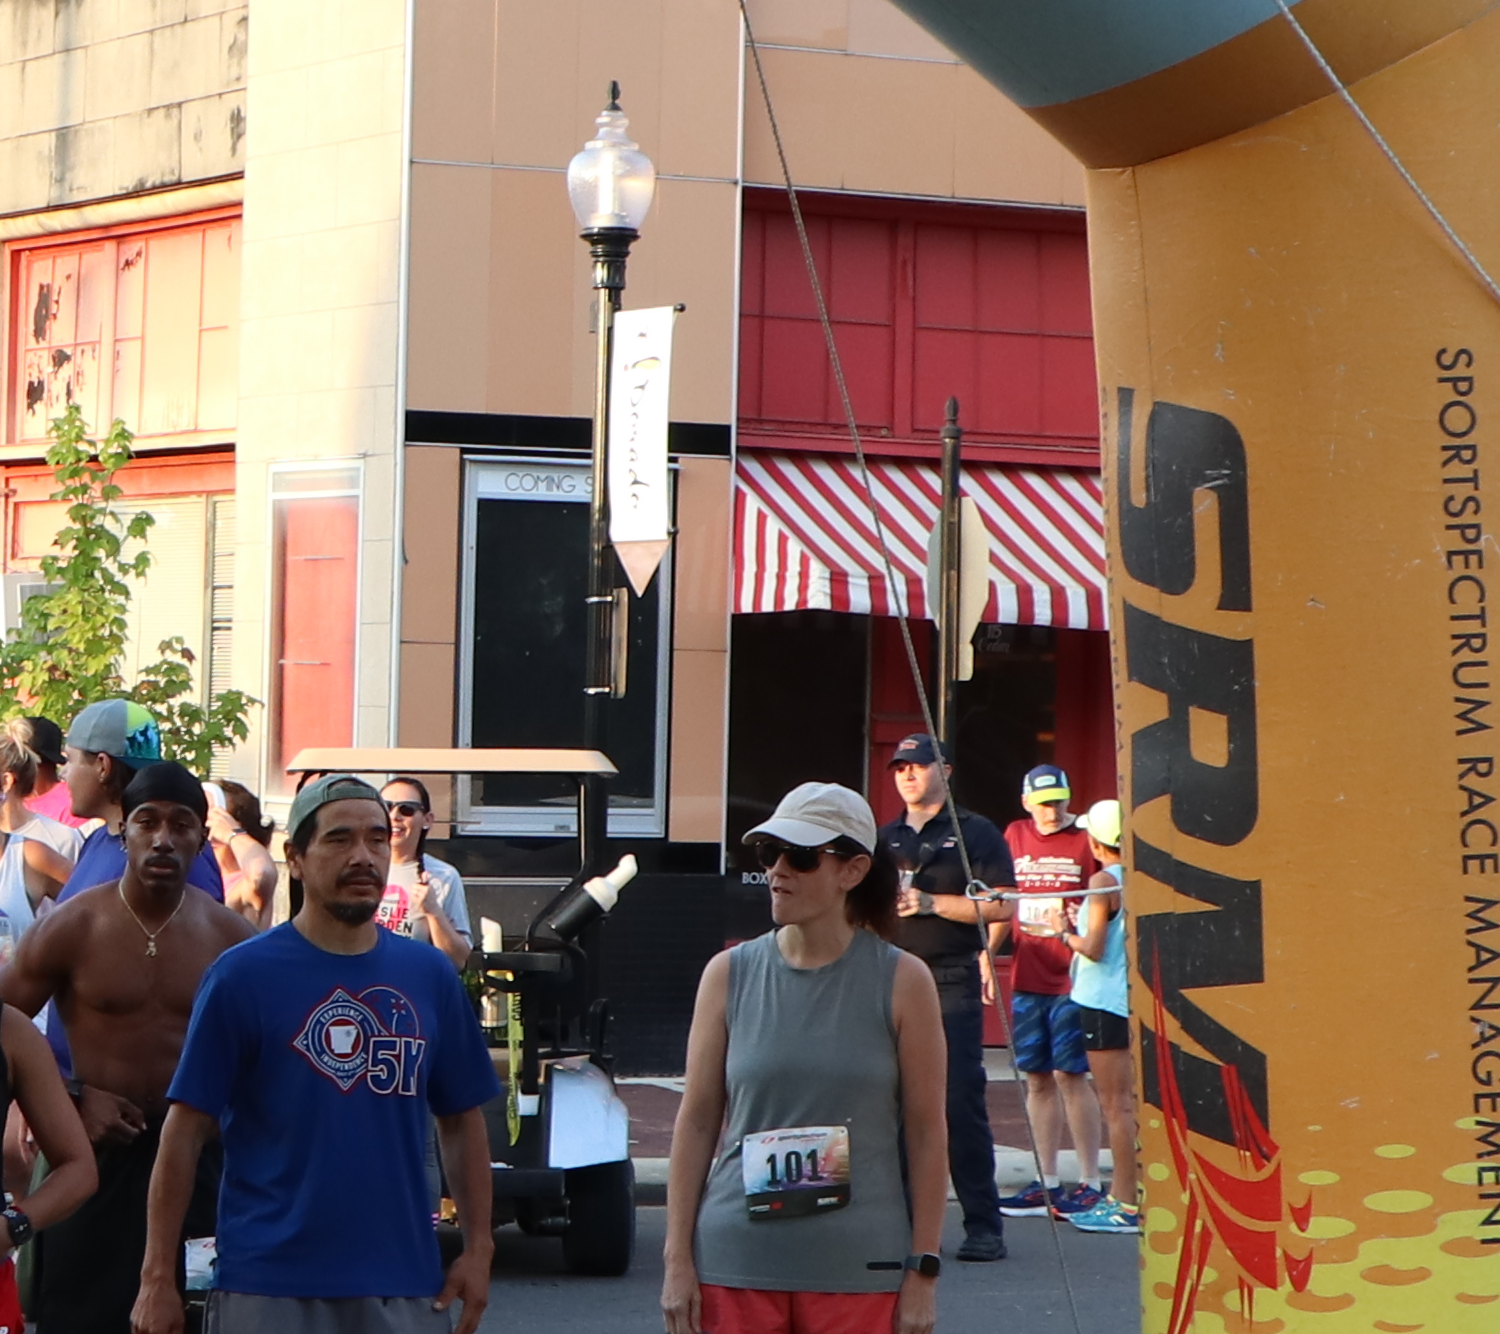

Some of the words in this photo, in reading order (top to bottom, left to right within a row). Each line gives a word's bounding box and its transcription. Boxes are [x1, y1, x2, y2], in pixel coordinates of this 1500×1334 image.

[1435, 347, 1494, 738] SPORTSPECTRUM
[1456, 755, 1500, 875] RACE
[742, 871, 768, 885] BOX
[380, 906, 409, 920] SLIE
[319, 1006, 364, 1024] EXPERIENCE
[766, 1148, 824, 1187] 101
